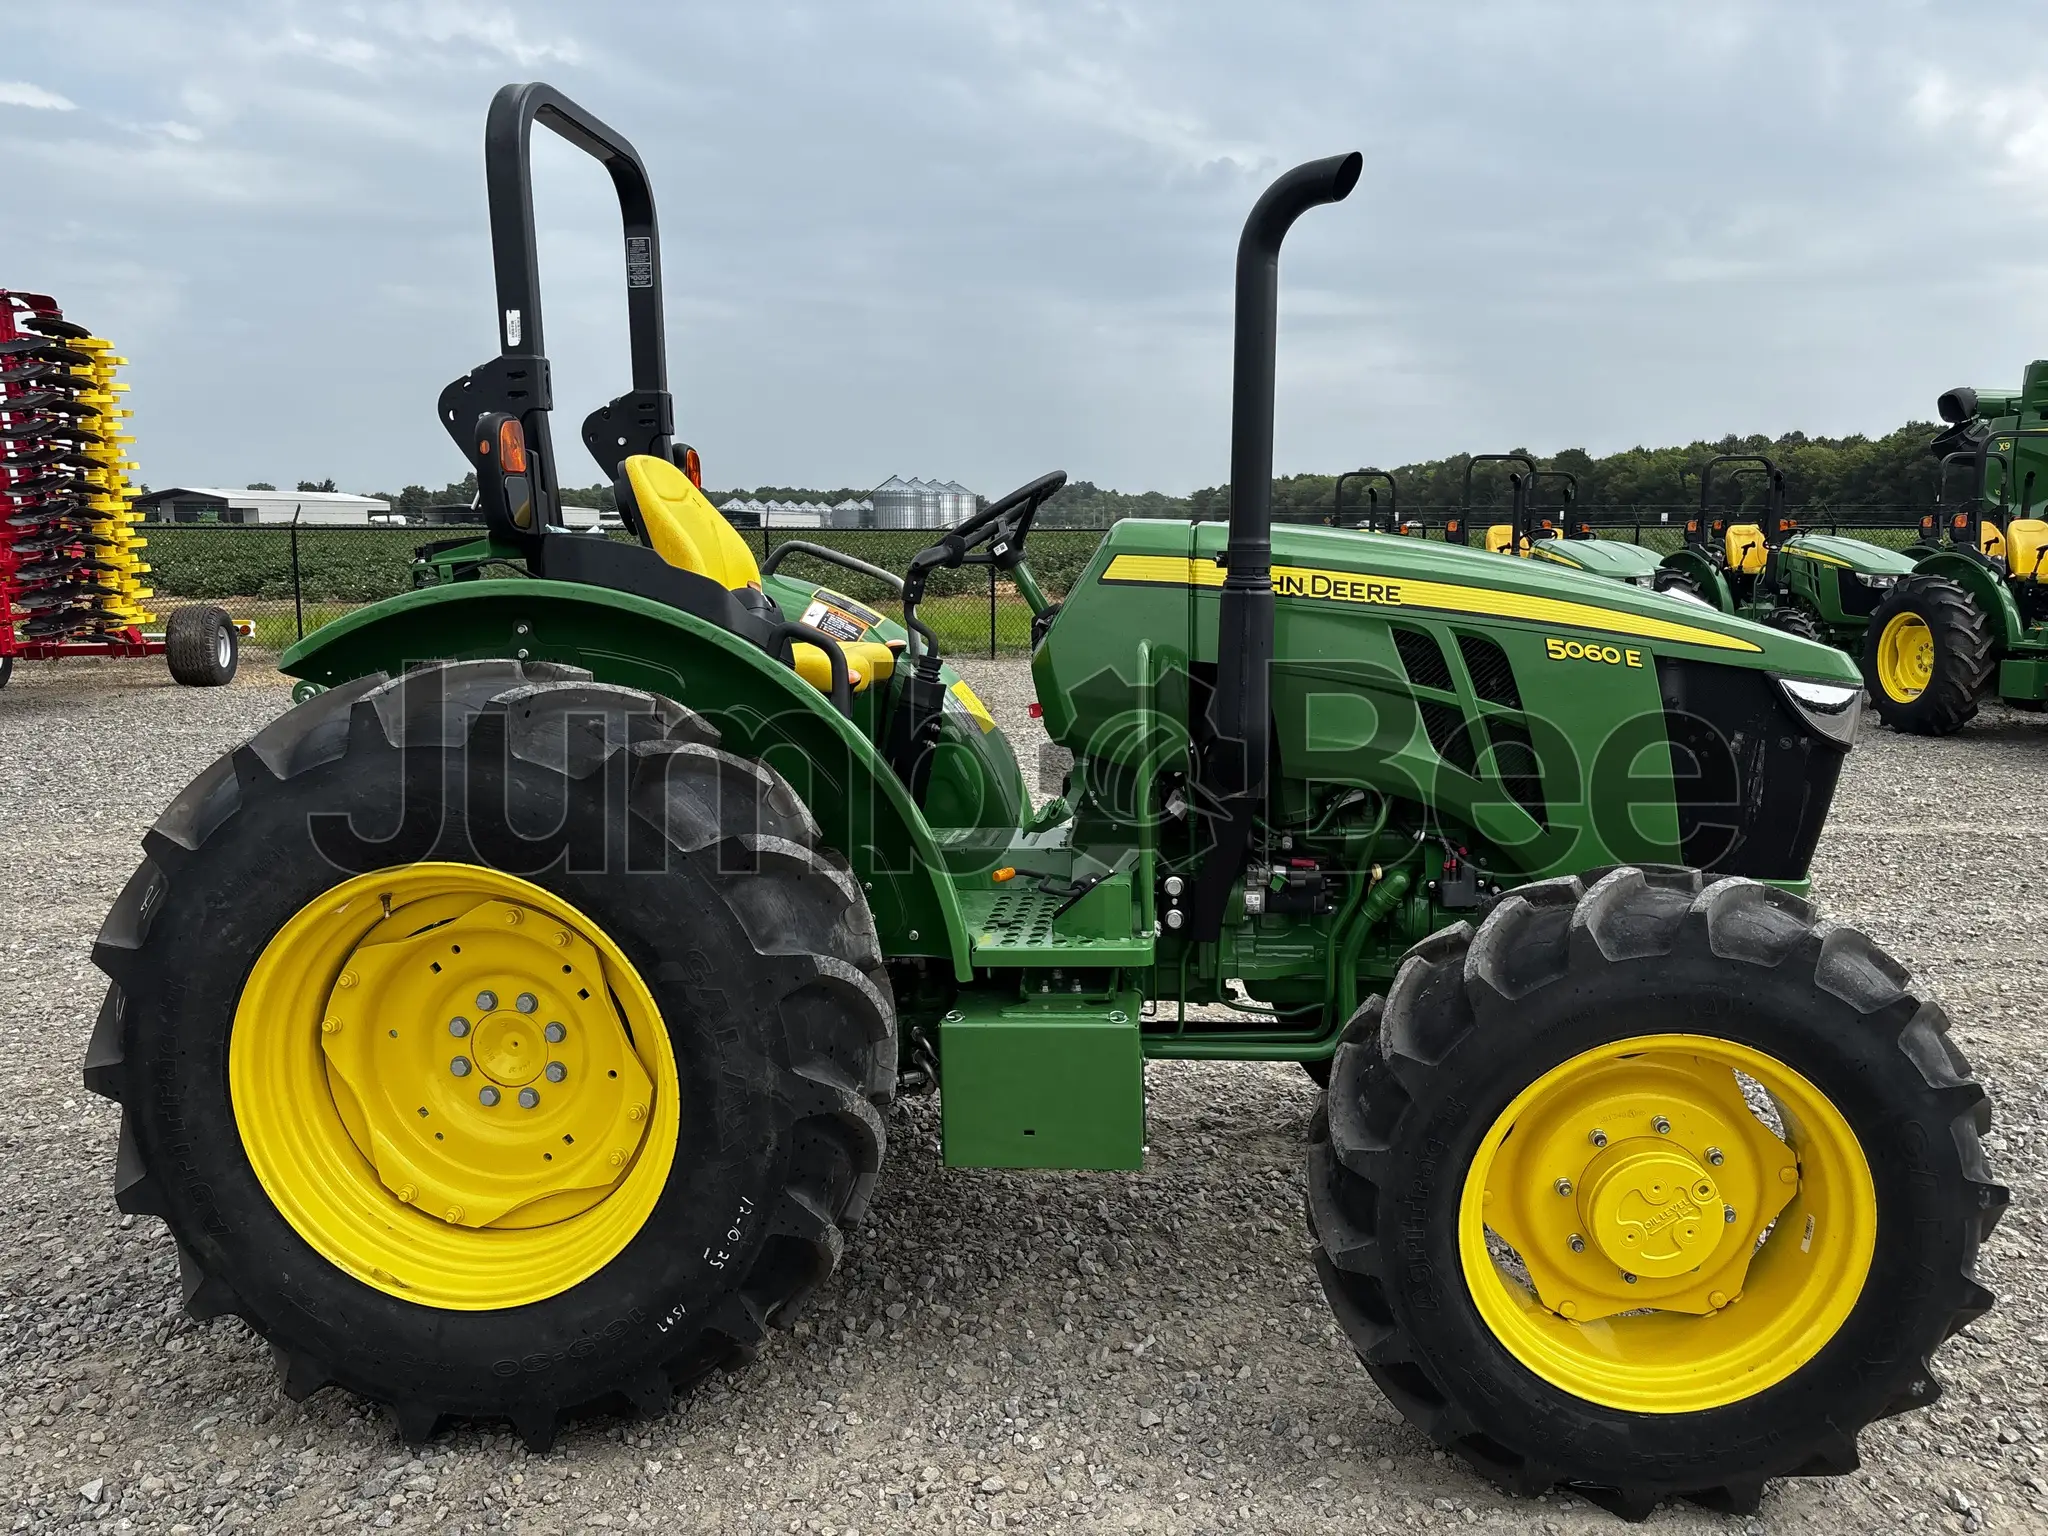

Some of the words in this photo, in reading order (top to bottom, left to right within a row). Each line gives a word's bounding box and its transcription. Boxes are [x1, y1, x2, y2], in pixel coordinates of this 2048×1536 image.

[1998, 441, 2011, 452] X9
[1311, 574, 1401, 603] DEERE
[1545, 637, 1621, 665] 5060
[1624, 648, 1644, 668] E
[1644, 1216, 1661, 1229] OIL
[1658, 1198, 1690, 1220] LEVEL
